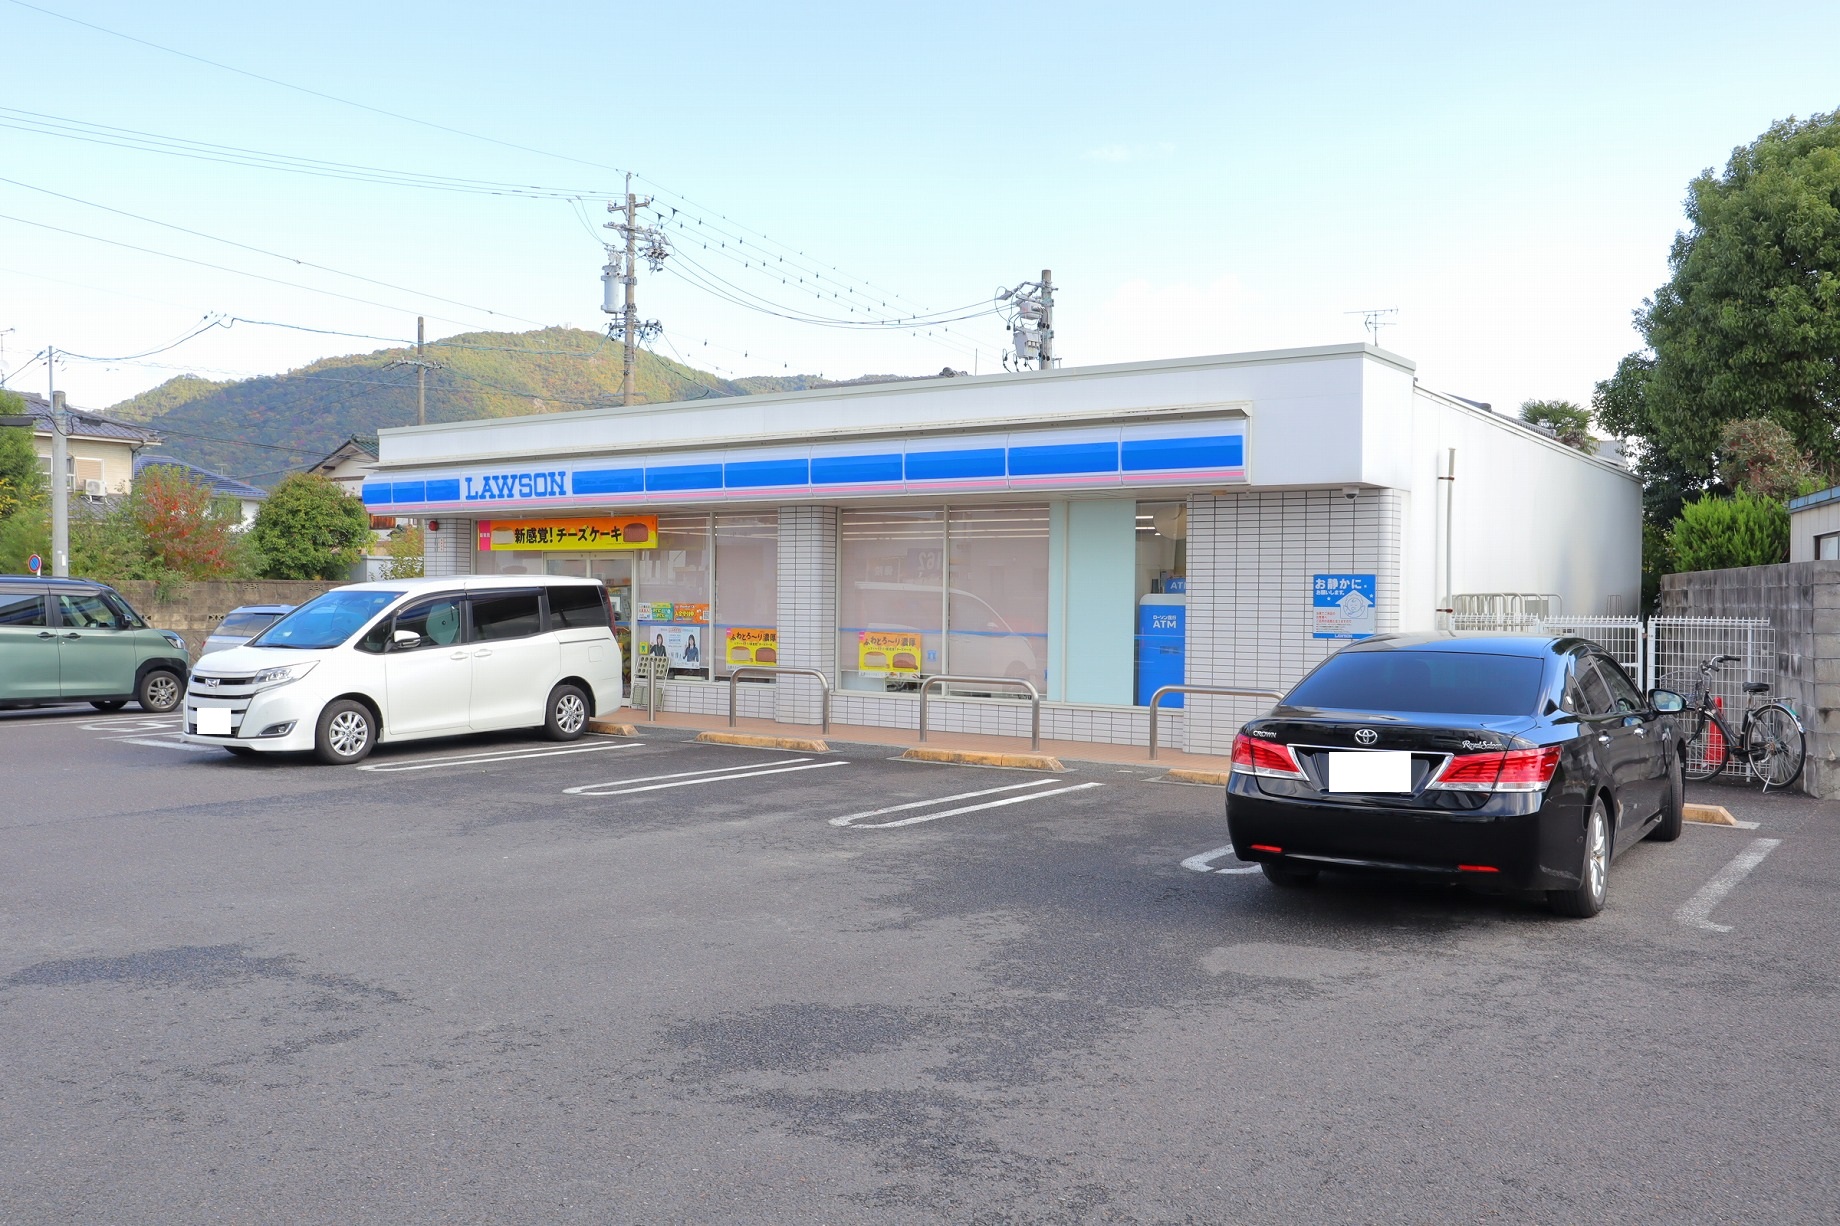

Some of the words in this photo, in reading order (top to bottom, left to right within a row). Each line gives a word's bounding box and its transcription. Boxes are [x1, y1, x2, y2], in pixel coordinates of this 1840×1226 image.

[465, 471, 566, 500] LAWSON
[514, 525, 622, 545] 新感覚!チーズケーキ
[1170, 581, 1186, 590] AT
[1315, 578, 1362, 590] お静かに
[1152, 621, 1177, 629] ATM
[1252, 730, 1277, 738] CROWN
[1462, 740, 1482, 750] Royal
